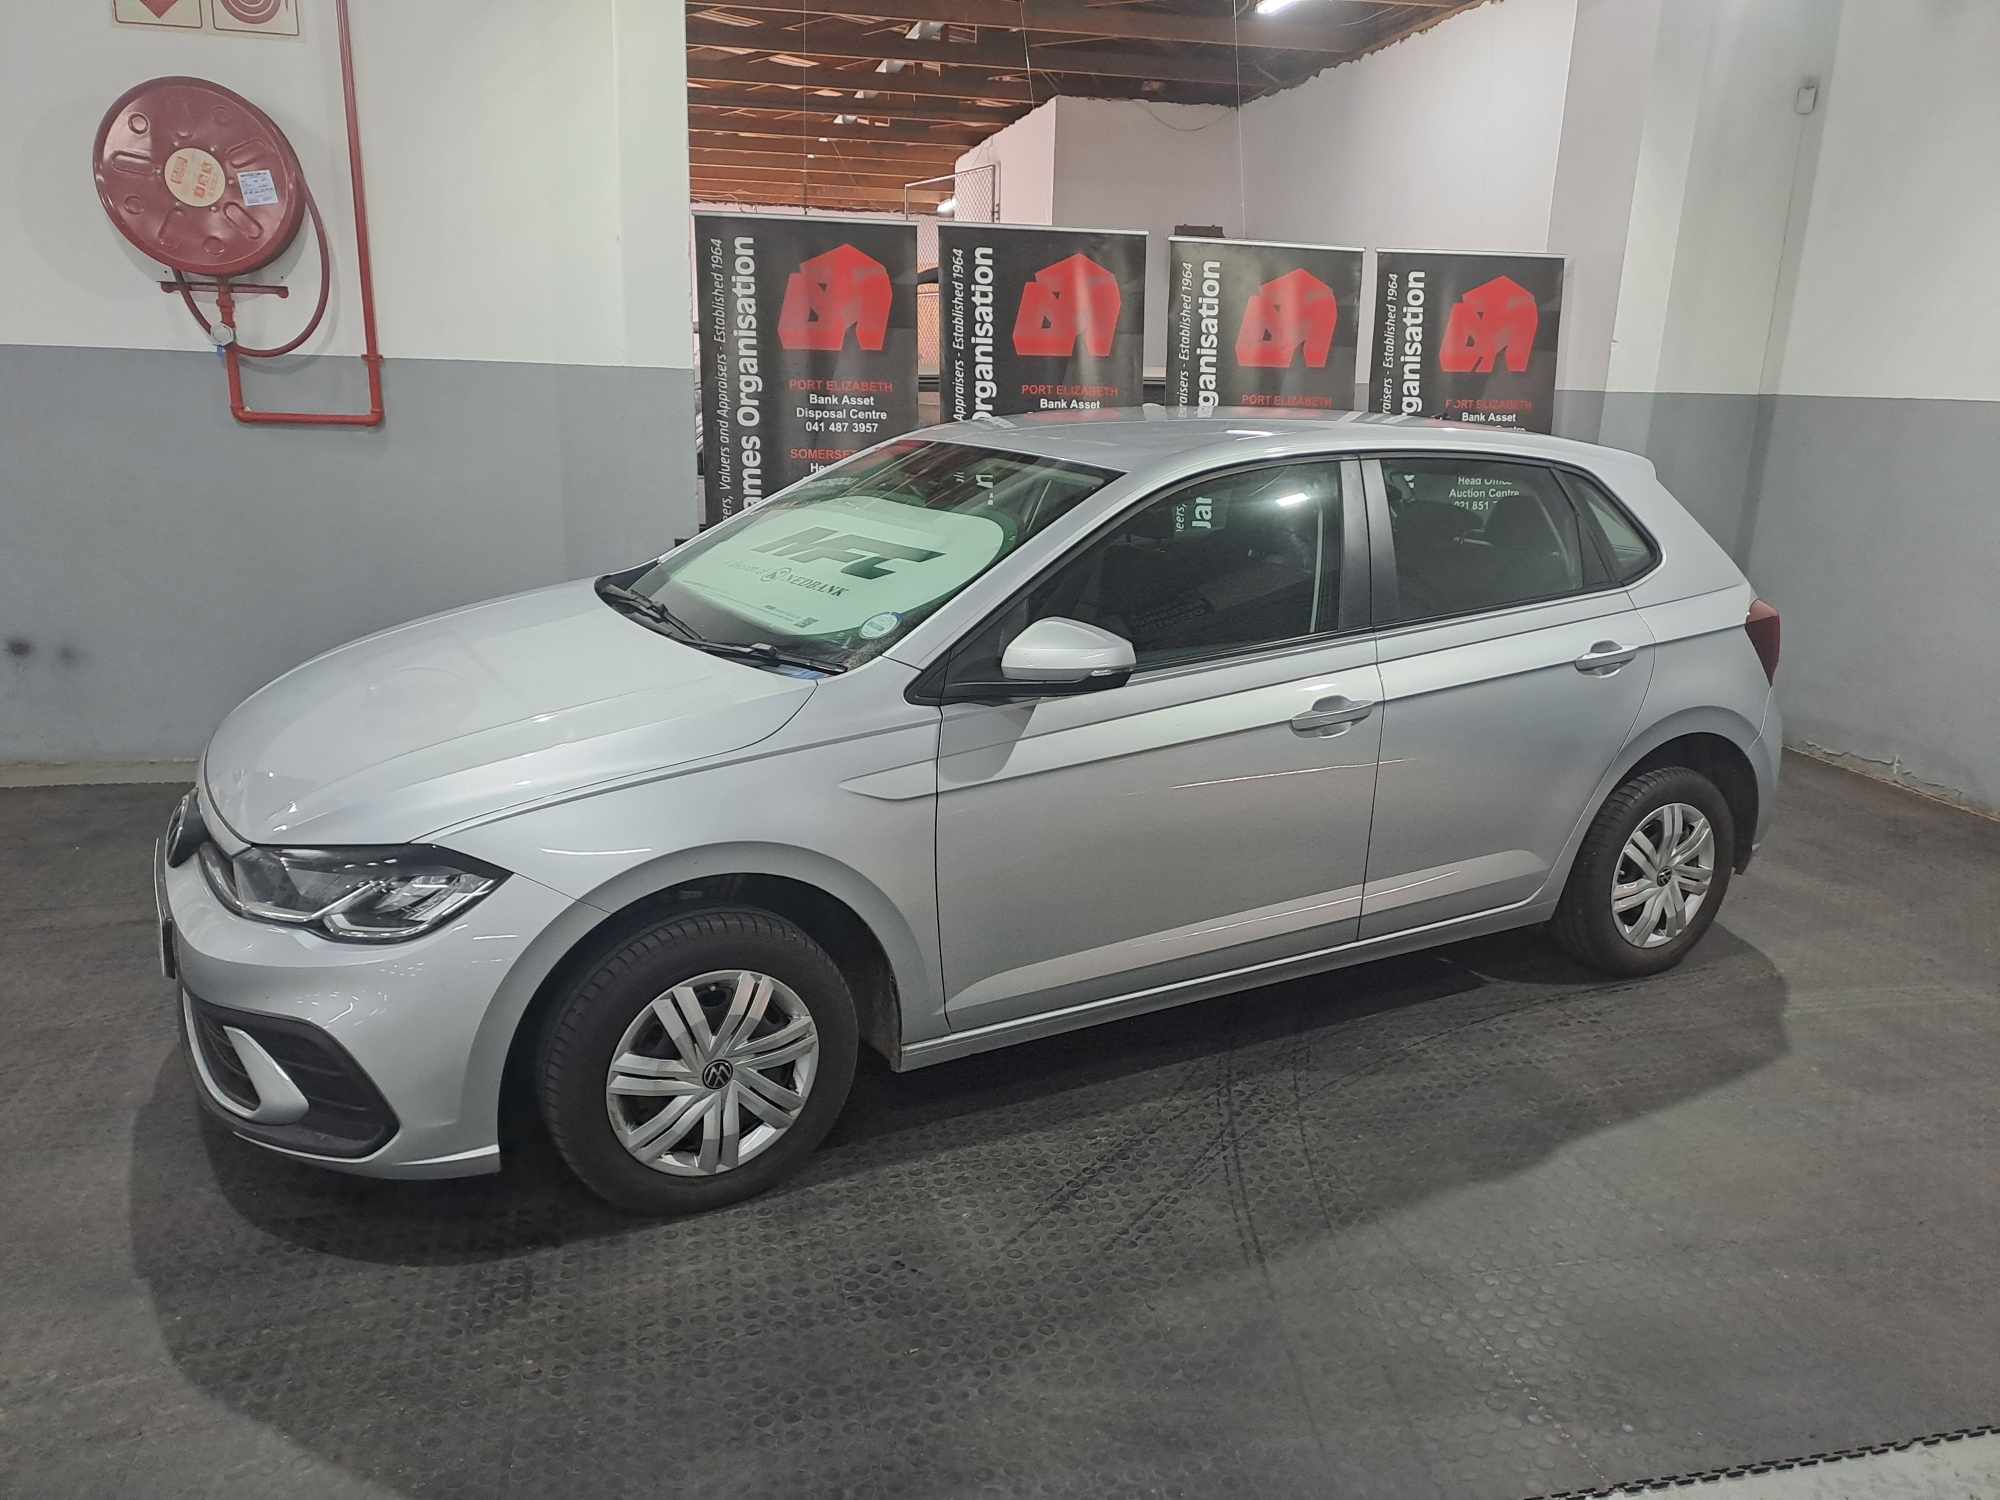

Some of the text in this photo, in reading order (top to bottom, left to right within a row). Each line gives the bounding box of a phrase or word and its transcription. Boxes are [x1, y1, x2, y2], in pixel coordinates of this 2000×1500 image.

[710, 238, 723, 269] 1964
[951, 247, 964, 279] 1964
[1181, 262, 1193, 292] 1964
[1387, 273, 1399, 301] 1964
[710, 271, 726, 343] Established
[951, 281, 964, 349] Established
[1178, 294, 1192, 361] Established
[1196, 260, 1221, 408] ganisation
[1382, 303, 1396, 368] Established
[1400, 271, 1426, 416] ganisation
[714, 353, 732, 418] Appraisers
[731, 236, 763, 510] ames Organisation
[789, 379, 893, 392] PORT ELIZABETH
[809, 393, 875, 406] Bank Asset
[952, 359, 967, 421] Appraisers
[1022, 384, 1119, 397] PORT ELIZABETH
[1176, 370, 1189, 408] raisers
[1241, 394, 1272, 406] PORT
[1380, 377, 1393, 415] raisers
[796, 407, 888, 420] Disposal Centre
[1039, 398, 1101, 410] Bank Asset
[1461, 411, 1517, 422] Bank Asset
[716, 420, 729, 443] and
[805, 421, 879, 433] 041 487 3957
[717, 447, 731, 490] Valuers
[790, 448, 853, 460] SOMERSE
[1448, 488, 1486, 498] Auction
[1472, 501, 1489, 511] 851
[720, 495, 734, 521] eers,
[1175, 503, 1187, 532] eers,
